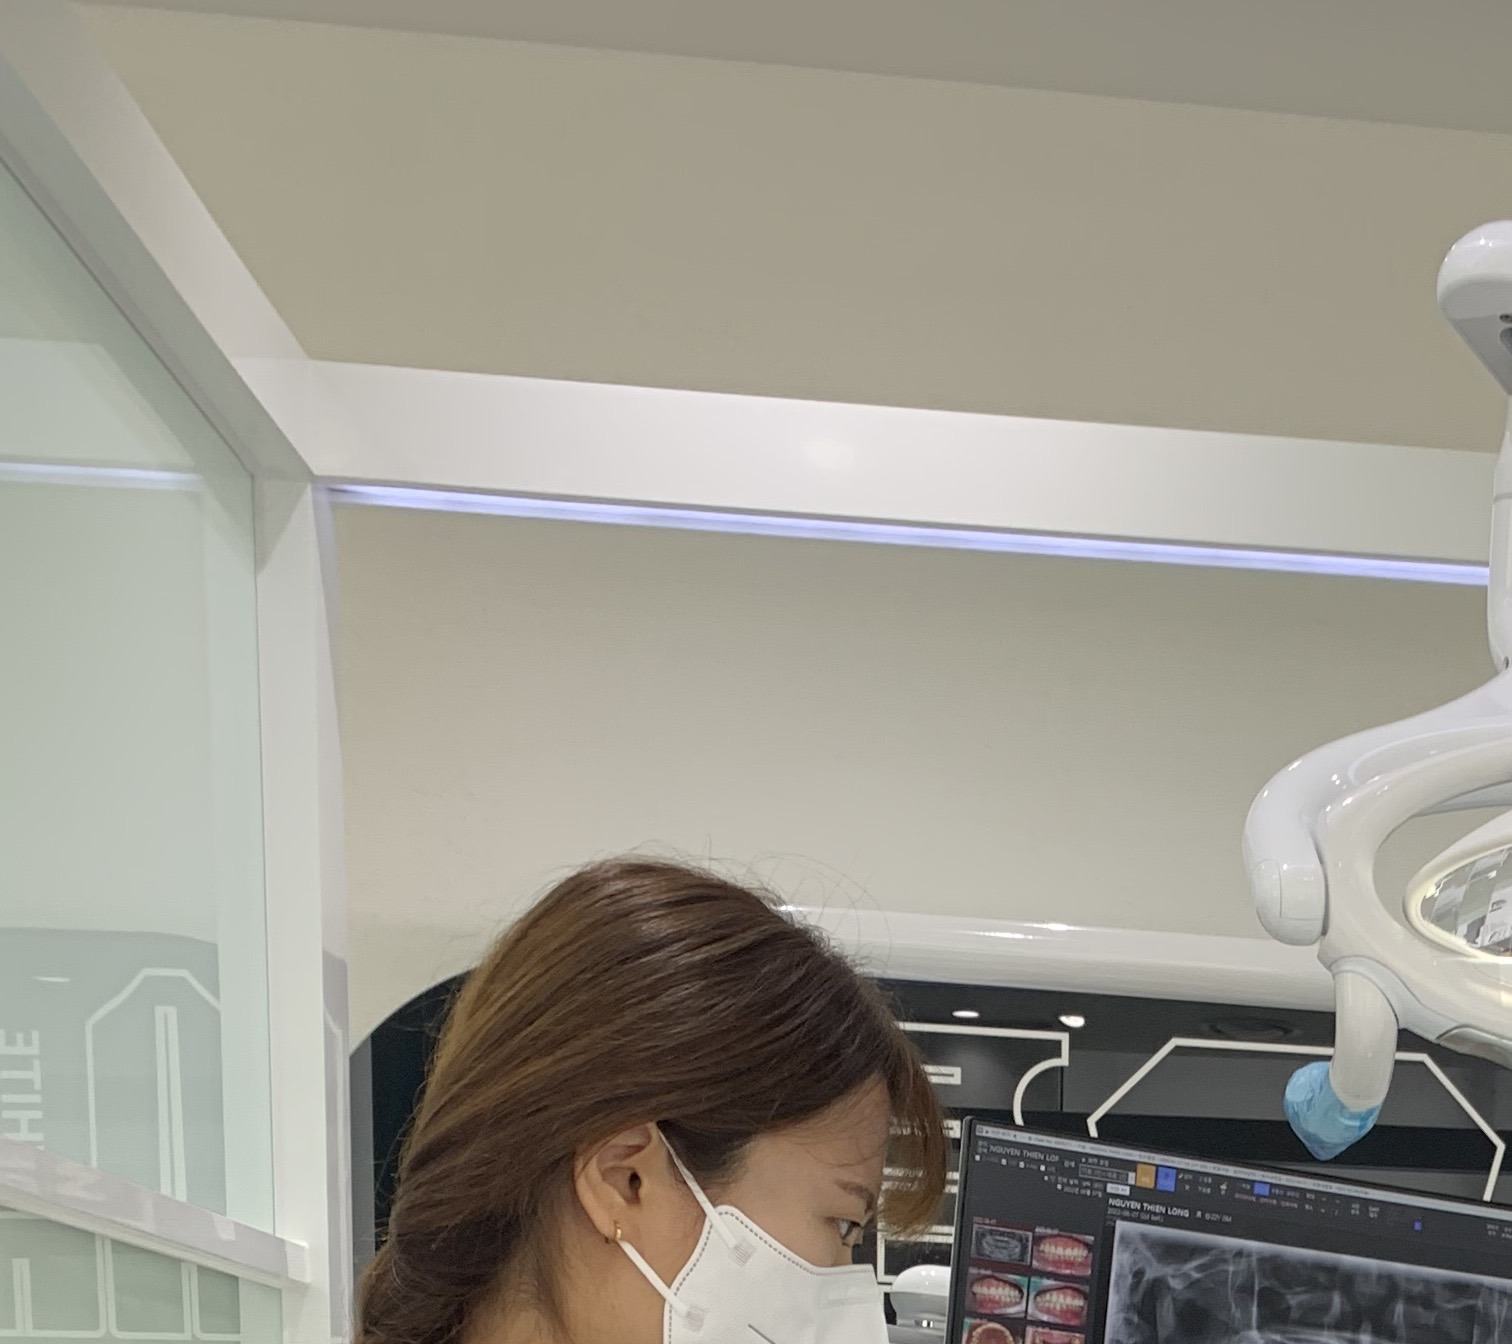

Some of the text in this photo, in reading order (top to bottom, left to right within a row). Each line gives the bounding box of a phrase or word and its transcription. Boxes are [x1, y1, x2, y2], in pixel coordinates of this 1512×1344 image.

[989, 1146, 1021, 1158] NGUYEN
[1108, 1197, 1141, 1210] NGUYEN
[1143, 1202, 1166, 1214] THIEN
[1167, 1205, 1190, 1218] LONG
